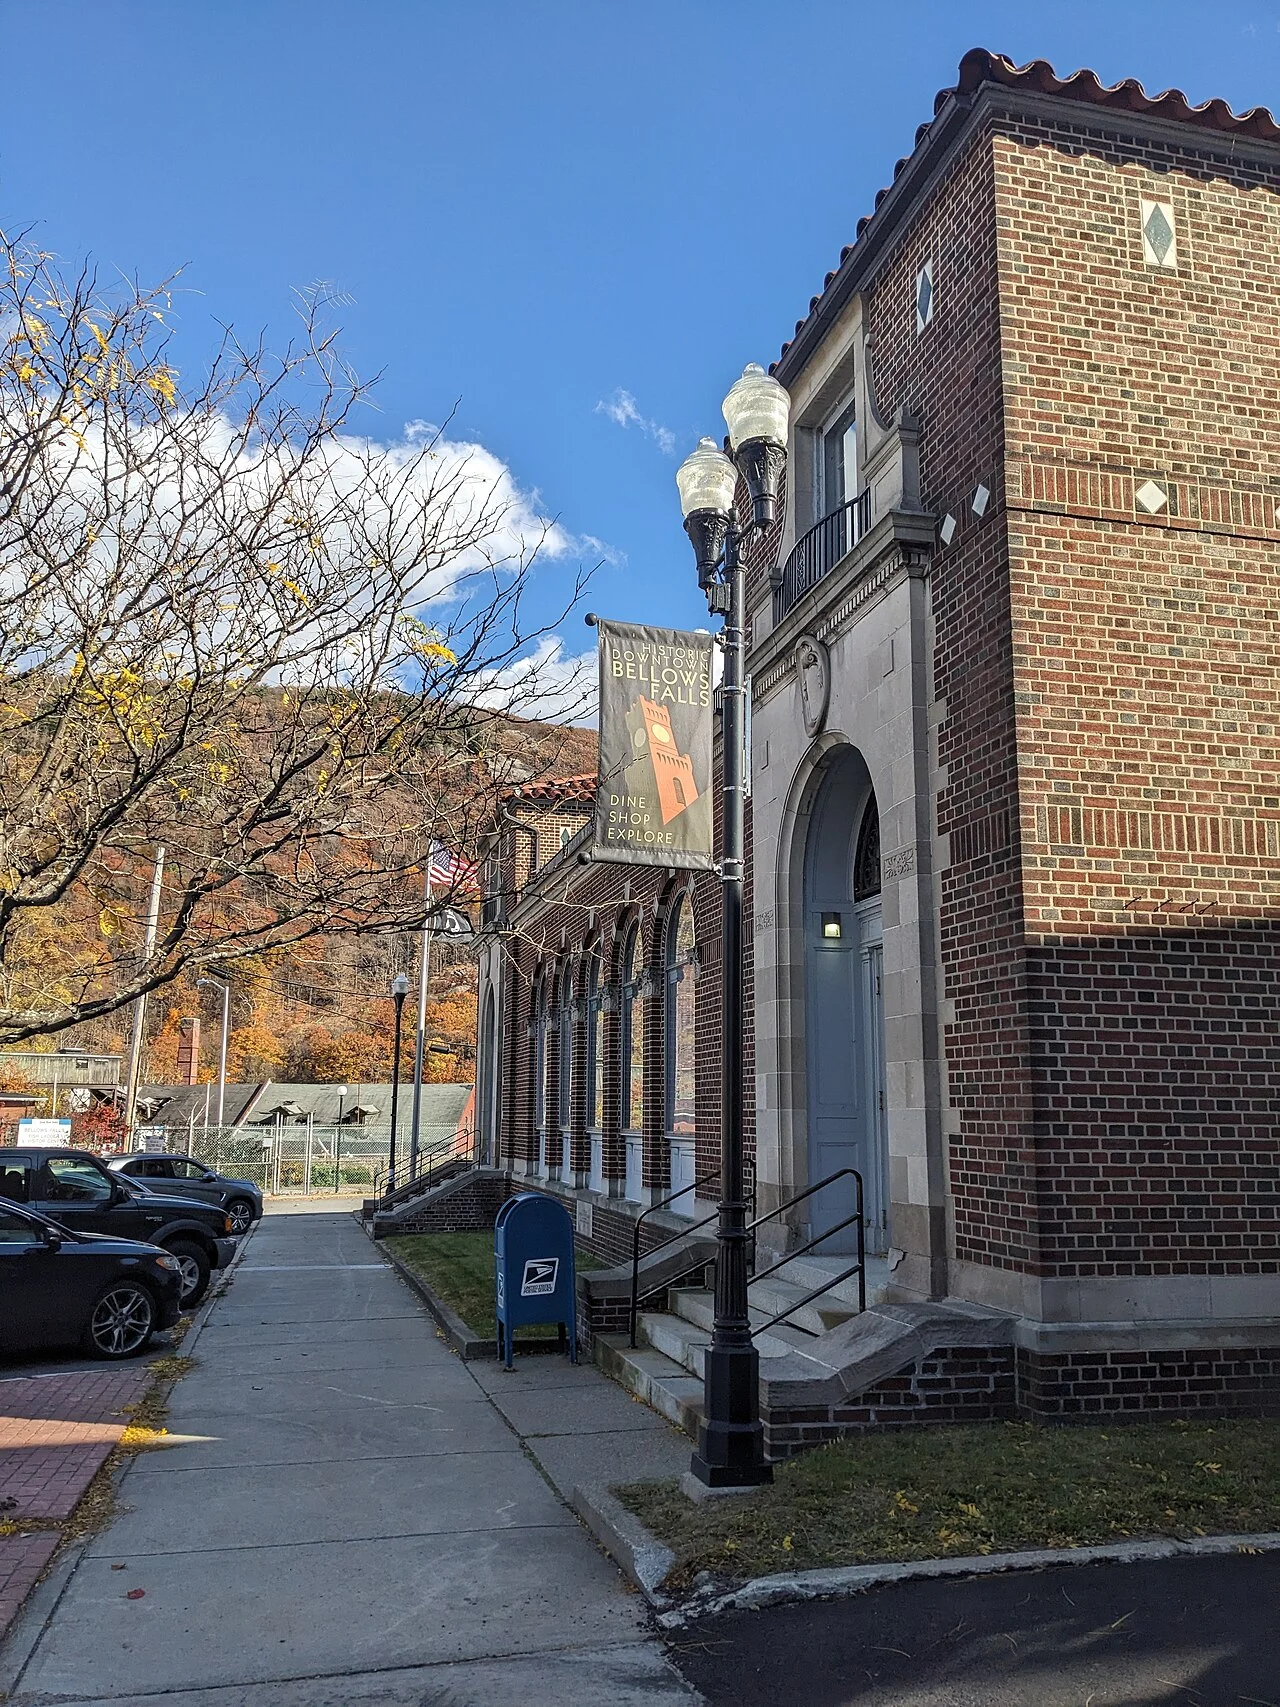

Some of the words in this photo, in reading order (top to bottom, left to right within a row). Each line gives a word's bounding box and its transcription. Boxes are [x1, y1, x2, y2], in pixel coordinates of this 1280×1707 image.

[612, 648, 708, 672] DOWNTOWN
[642, 642, 709, 662] HISTORIC
[612, 660, 709, 690] BELLOWS
[650, 683, 709, 707] FALLS
[610, 794, 646, 809] DINE
[609, 811, 650, 825] SHOP
[607, 828, 673, 844] EXPLORE
